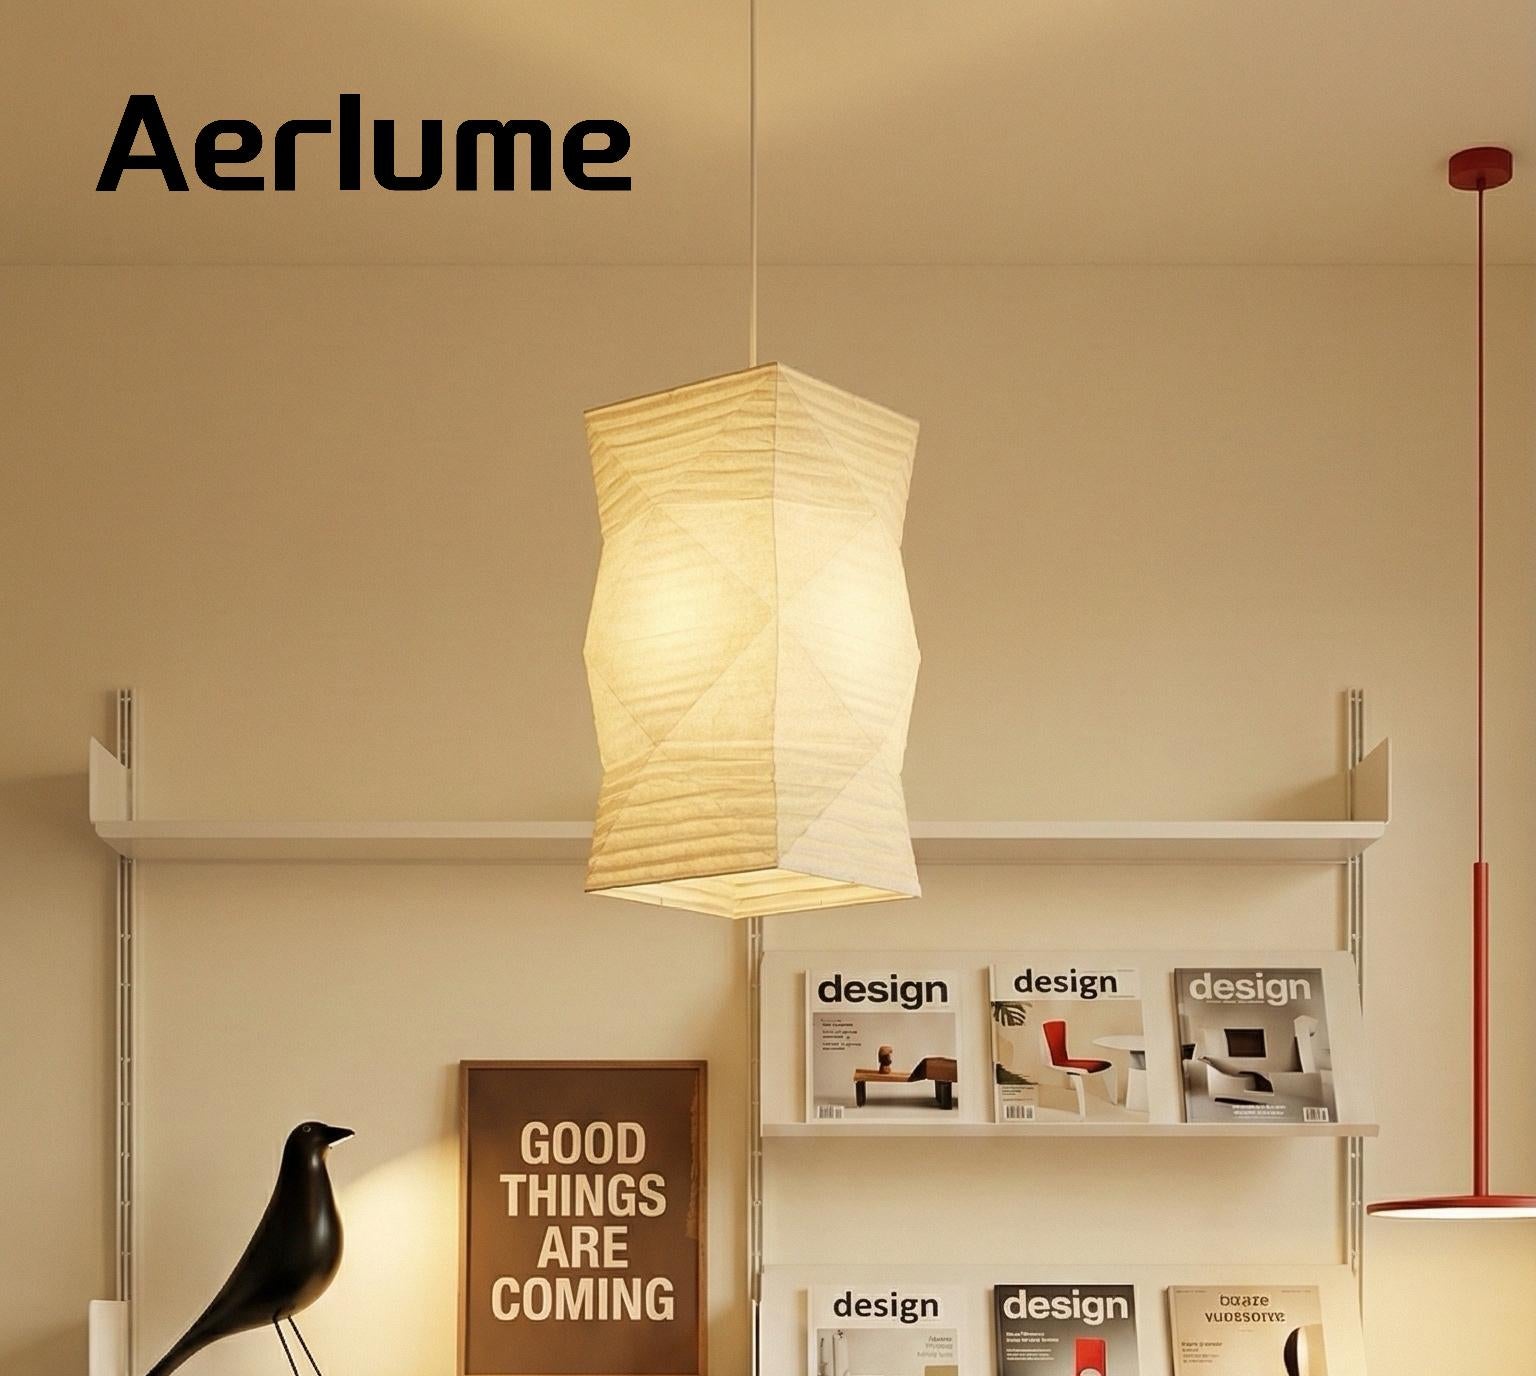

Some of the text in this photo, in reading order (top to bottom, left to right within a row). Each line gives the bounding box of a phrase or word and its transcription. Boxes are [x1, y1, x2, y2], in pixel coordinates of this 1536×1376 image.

[818, 974, 948, 1010] design
[1014, 968, 1117, 1000] design
[1189, 972, 1312, 1006] design
[520, 1121, 646, 1165] GOOD
[499, 1173, 667, 1218] THINGS
[537, 1225, 629, 1269] ARE
[491, 1277, 674, 1322] COMING
[833, 1291, 939, 1324] design
[1003, 1289, 1129, 1325] design
